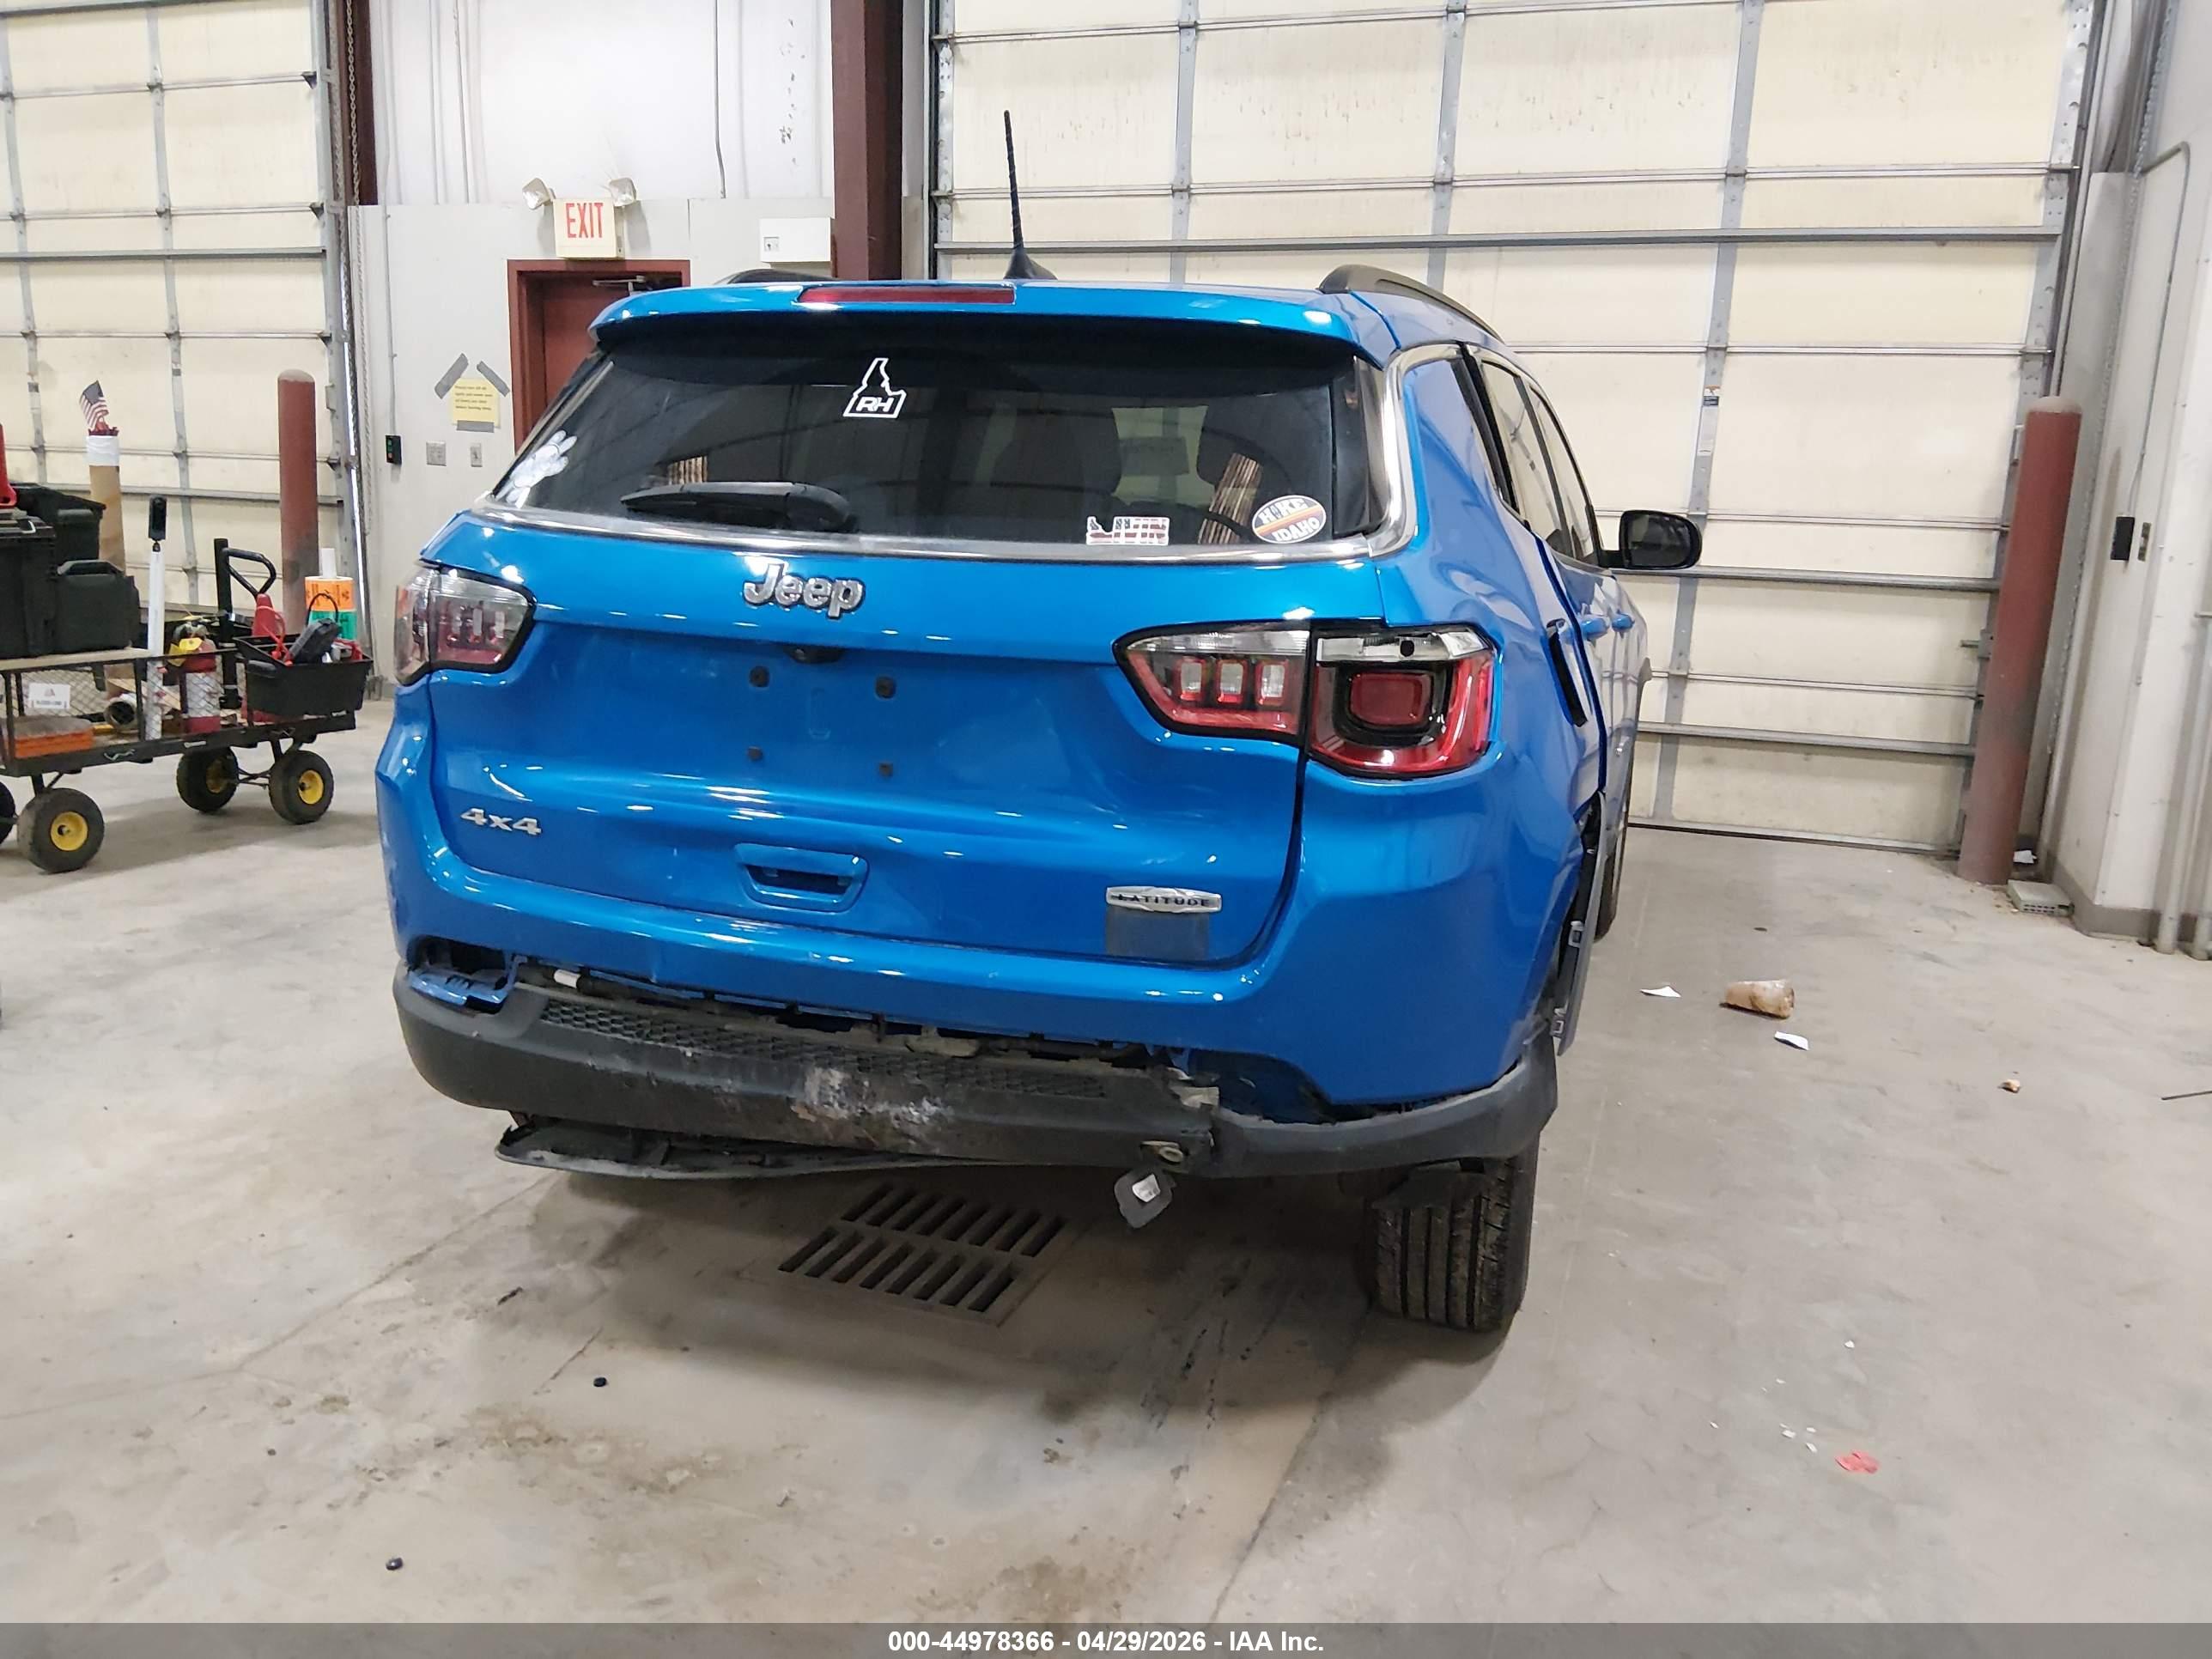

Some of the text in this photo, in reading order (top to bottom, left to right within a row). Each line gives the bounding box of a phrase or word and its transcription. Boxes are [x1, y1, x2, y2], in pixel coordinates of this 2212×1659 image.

[565, 202, 604, 238] EXIT
[855, 396, 895, 411] RH
[1272, 517, 1320, 542] IDAHO
[743, 562, 865, 618] Jeep
[460, 808, 542, 836] 4x4
[1118, 893, 1210, 907] LATITUDE
